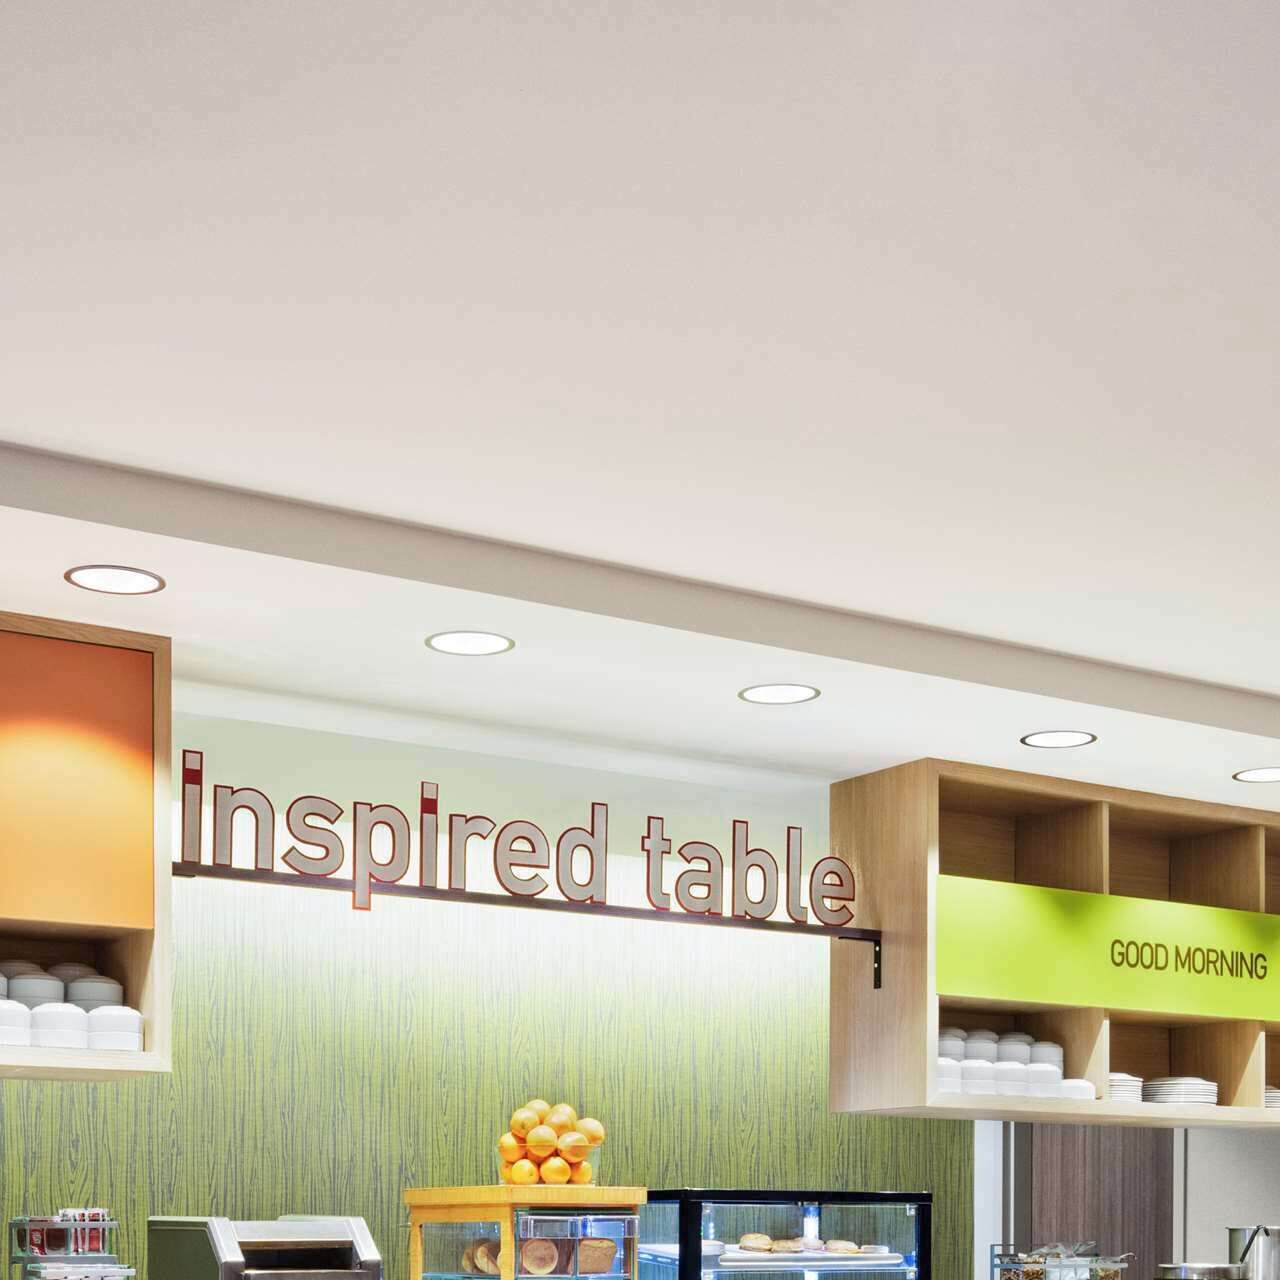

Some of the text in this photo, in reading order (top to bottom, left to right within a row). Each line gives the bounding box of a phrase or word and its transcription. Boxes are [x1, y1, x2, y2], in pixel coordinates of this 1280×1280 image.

[182, 749, 856, 926] inspired table
[1110, 939, 1268, 981] GOOD MORNING
